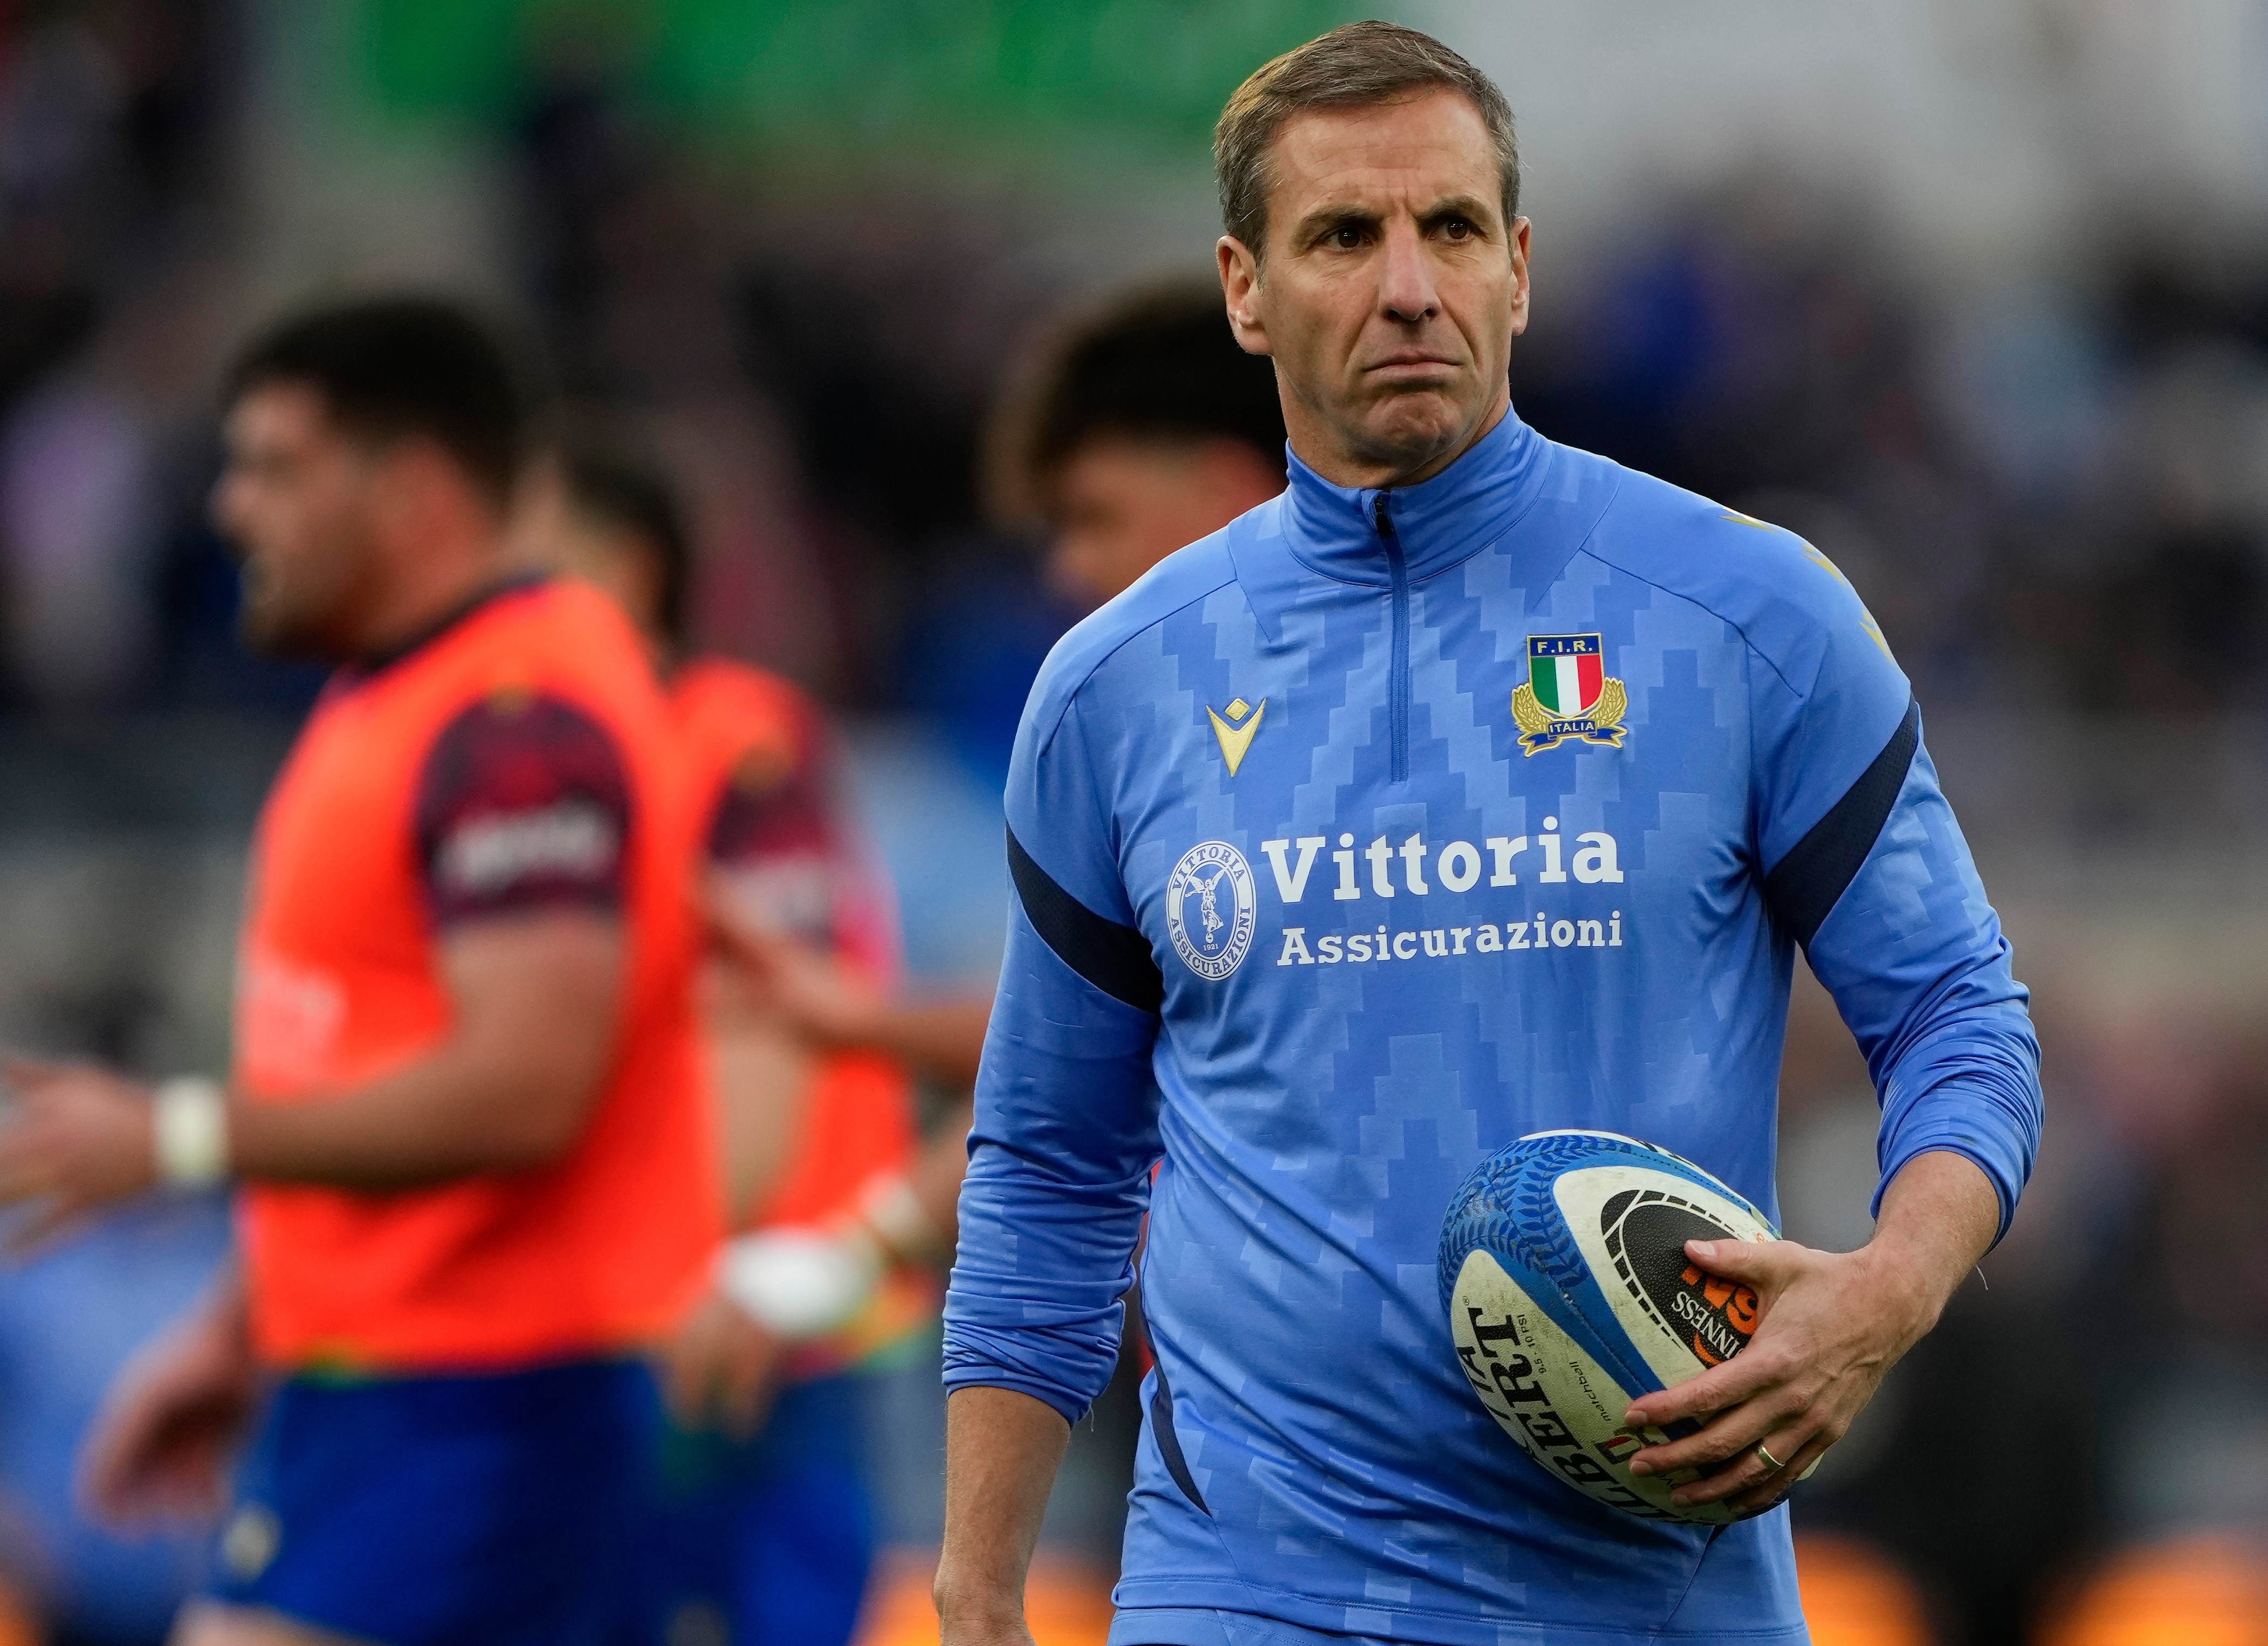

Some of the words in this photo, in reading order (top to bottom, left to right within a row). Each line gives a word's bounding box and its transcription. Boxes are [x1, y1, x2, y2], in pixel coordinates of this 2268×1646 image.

[1537, 640, 1593, 654] F.I.R.
[1549, 721, 1595, 733] ITALIA
[1172, 847, 1245, 889] VITTORIA
[1261, 816, 1624, 903] Vittoria
[1171, 907, 1250, 975] ASSICURAZIONI
[1202, 943, 1219, 951] 1921
[1276, 910, 1623, 966] Assicurazioni
[1517, 1314, 1529, 1333] PSI
[1525, 1336, 1536, 1348] 10
[1672, 1291, 1744, 1359] INNESS
[1569, 1361, 1611, 1421] matchball
